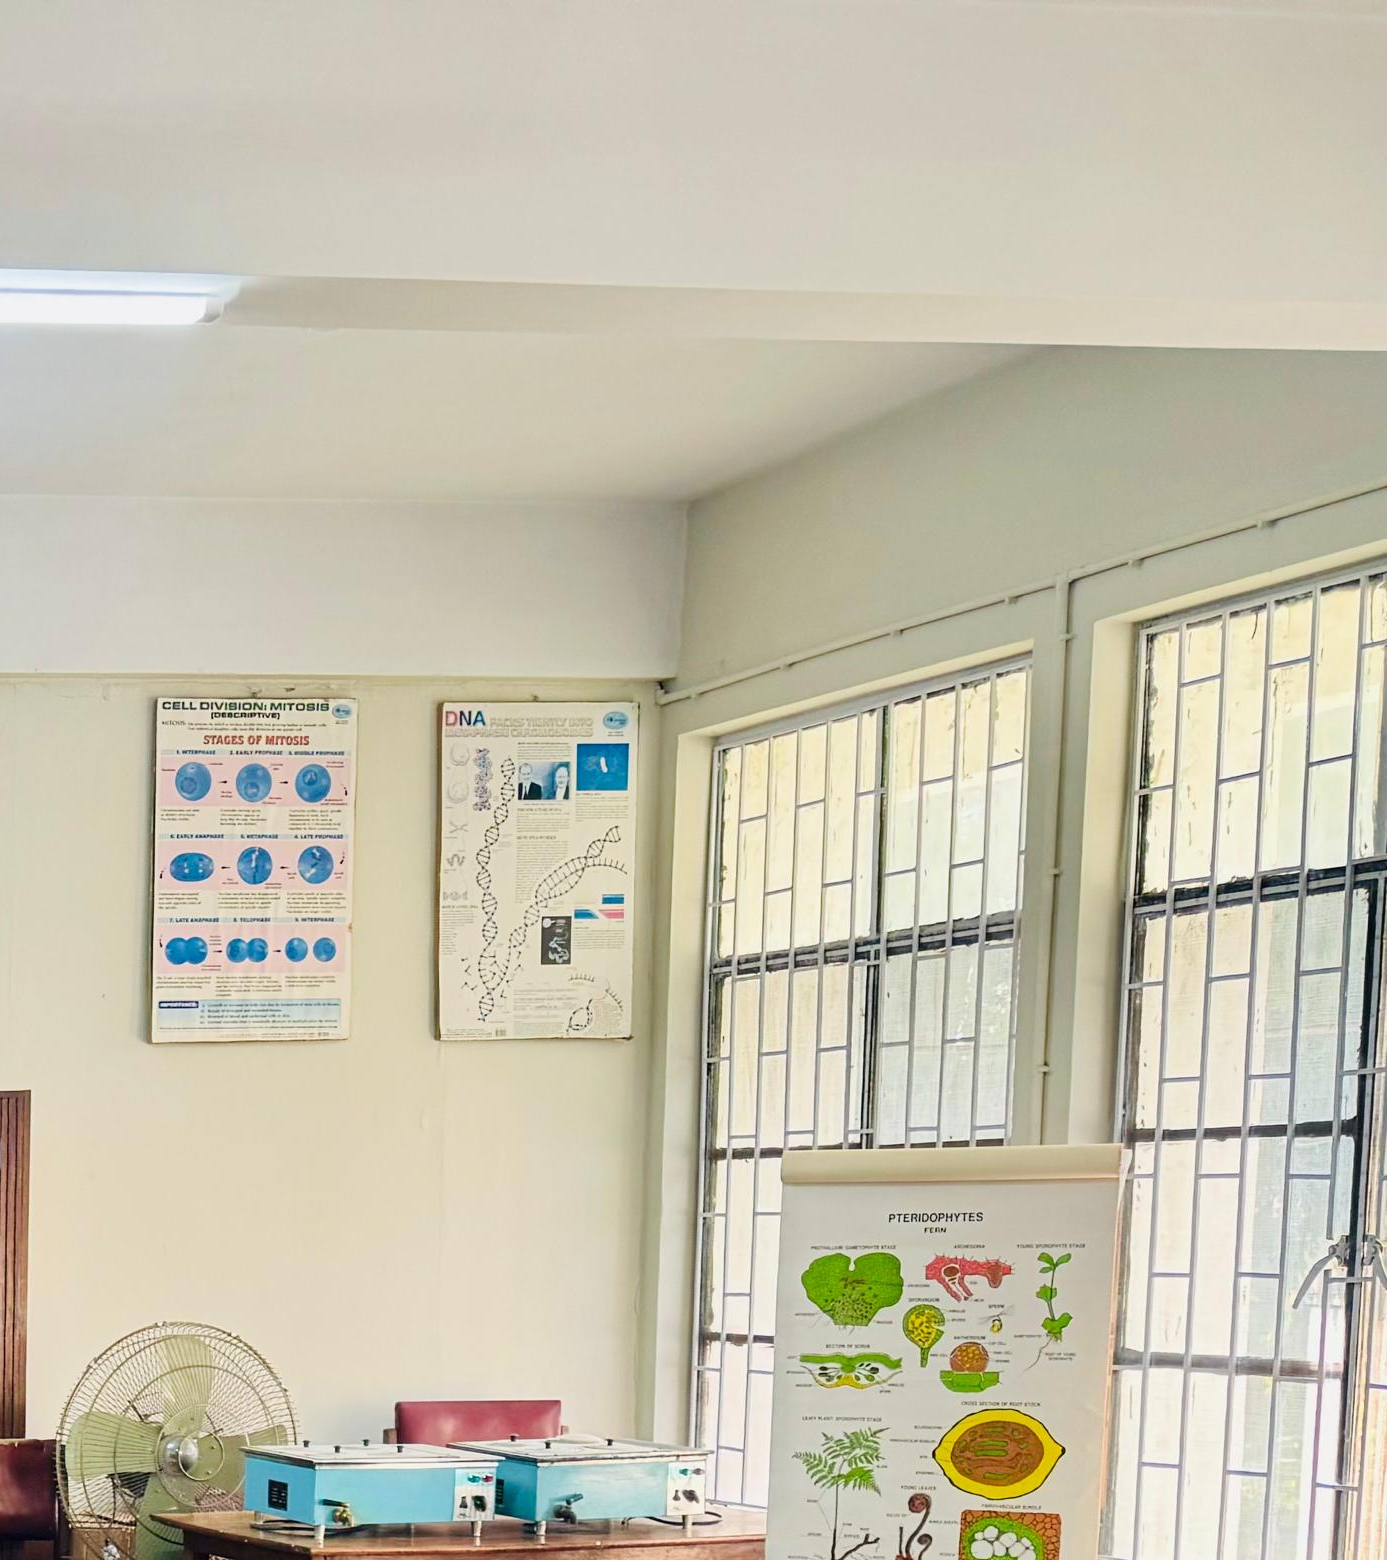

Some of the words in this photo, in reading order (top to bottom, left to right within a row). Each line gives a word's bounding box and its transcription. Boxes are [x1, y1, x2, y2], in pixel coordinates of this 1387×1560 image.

[162, 701, 197, 710] CELL
[200, 701, 267, 711] DIVISION:
[269, 702, 330, 711] MITOSIS
[211, 711, 281, 720] (DESCRIPTIVE)
[445, 710, 486, 727] DNA
[203, 735, 244, 745] STAGES
[248, 735, 262, 745] OF
[265, 735, 310, 746] MITOSIS
[888, 1211, 984, 1223] PTERIDOPHYTES
[924, 1226, 947, 1234] FERN
